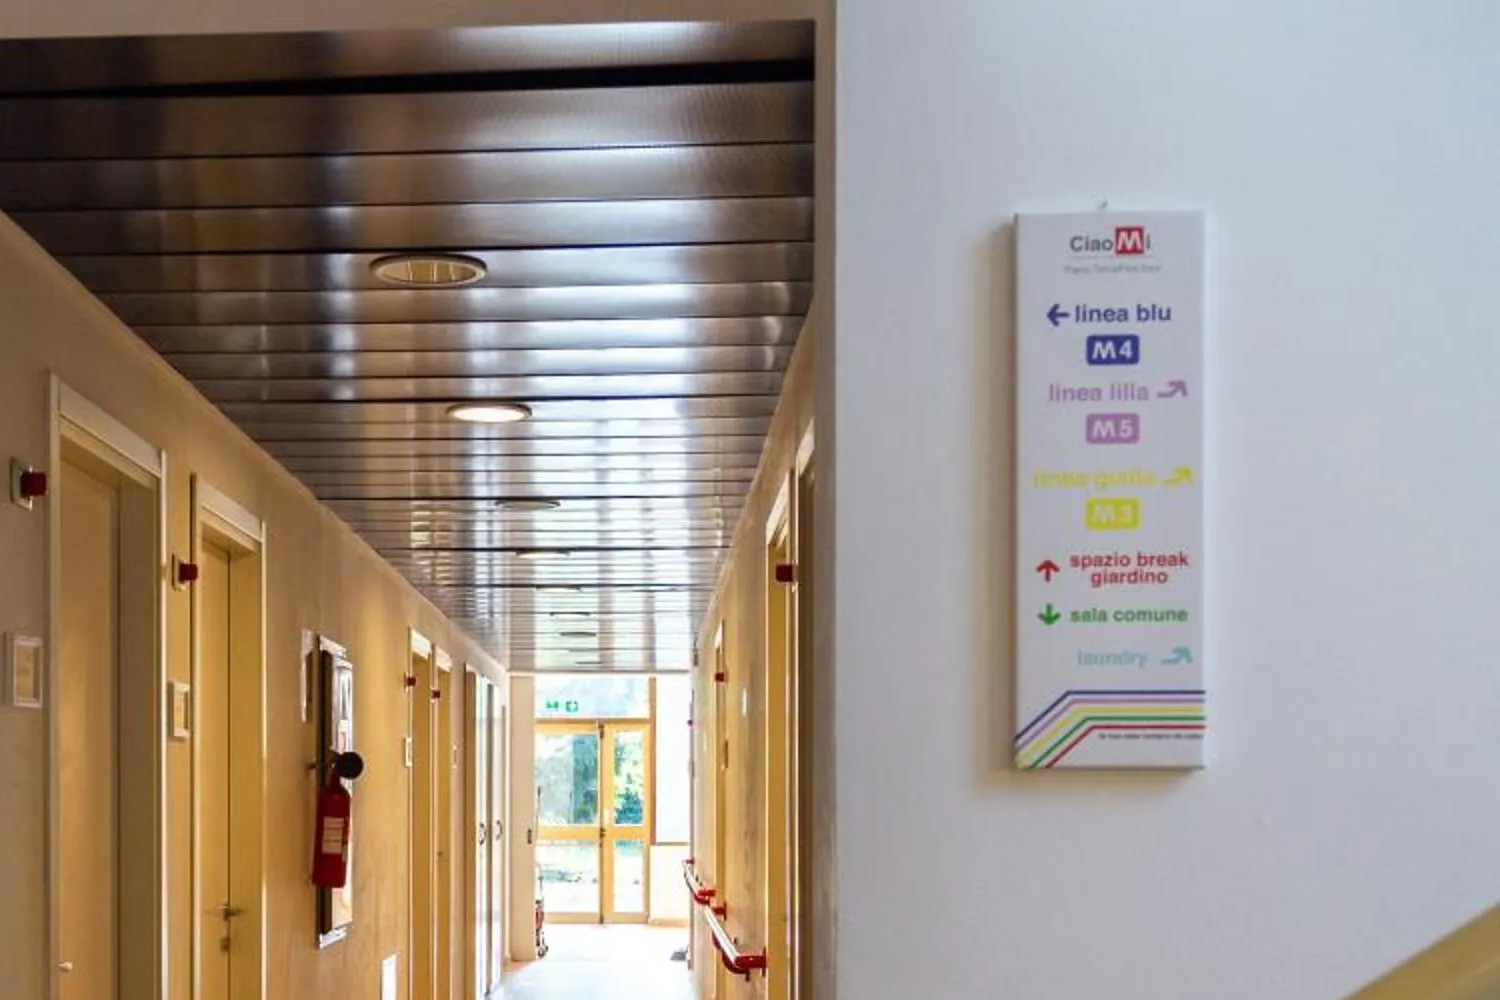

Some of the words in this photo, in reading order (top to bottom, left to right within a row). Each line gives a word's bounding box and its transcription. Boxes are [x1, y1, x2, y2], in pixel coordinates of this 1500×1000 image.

[1075, 304, 1129, 323] linea
[1136, 304, 1172, 322] blu
[1091, 340, 1133, 359] M4
[1048, 383, 1103, 402] linea
[1110, 383, 1149, 401] lilla
[1091, 418, 1134, 439] M5
[1069, 552, 1131, 571] spazio
[1136, 551, 1189, 567] break
[1090, 567, 1168, 588] giardino
[1070, 606, 1108, 623] sala
[1113, 608, 1189, 623] comune
[1077, 650, 1147, 669] laundry
